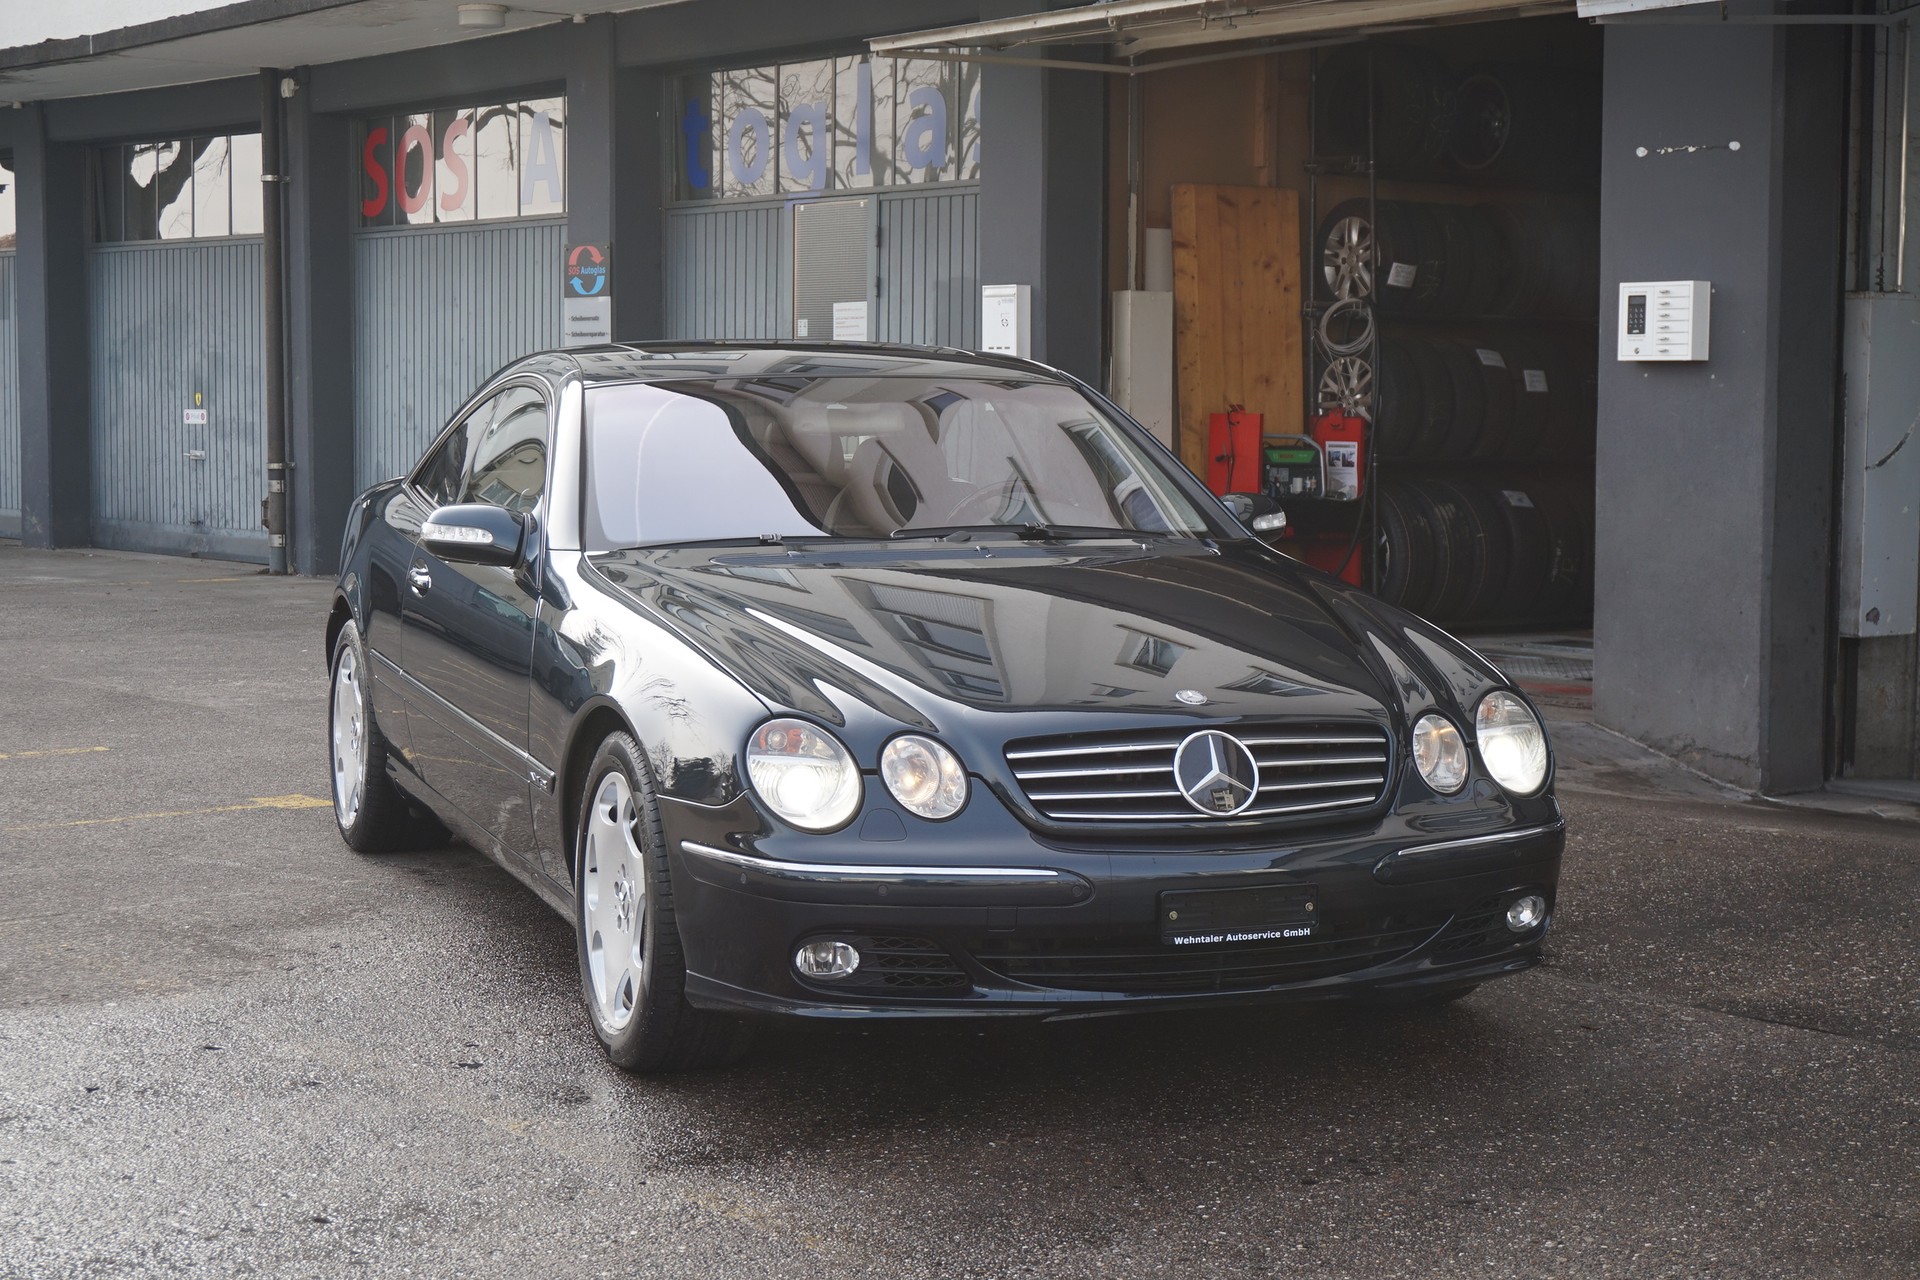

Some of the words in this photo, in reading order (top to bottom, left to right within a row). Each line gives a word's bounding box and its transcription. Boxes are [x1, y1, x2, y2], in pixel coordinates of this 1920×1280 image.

[682, 63, 980, 212] togla
[362, 118, 469, 217] SOS
[568, 266, 580, 275] SOS
[580, 264, 606, 276] Autoglas
[1174, 934, 1224, 945] Wehntaler
[1226, 930, 1281, 942] Autoservice
[1283, 928, 1311, 937] GmbH
